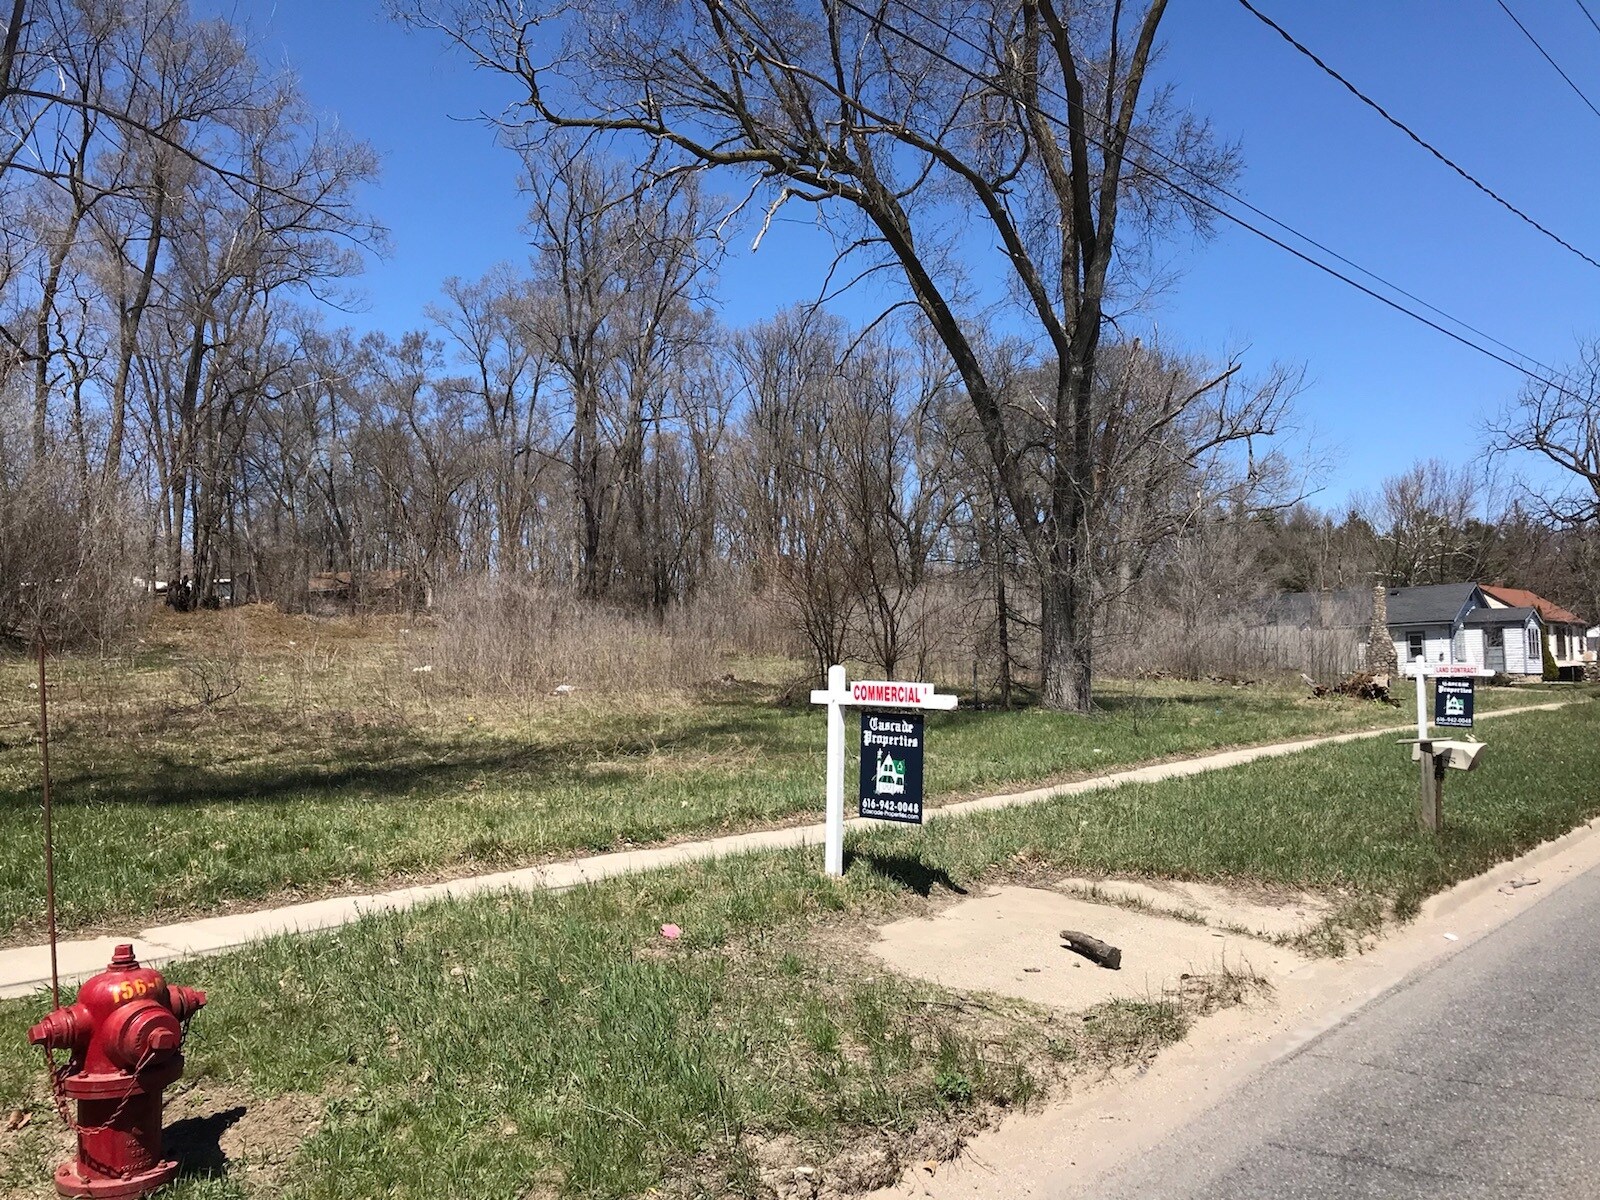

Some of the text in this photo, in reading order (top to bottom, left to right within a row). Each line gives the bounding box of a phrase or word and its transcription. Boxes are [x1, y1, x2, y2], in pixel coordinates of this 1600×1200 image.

[854, 685, 921, 703] COMMERCIAL
[869, 717, 914, 733] Cascade
[863, 730, 919, 748] Properties
[862, 798, 920, 814] 616-942-0048
